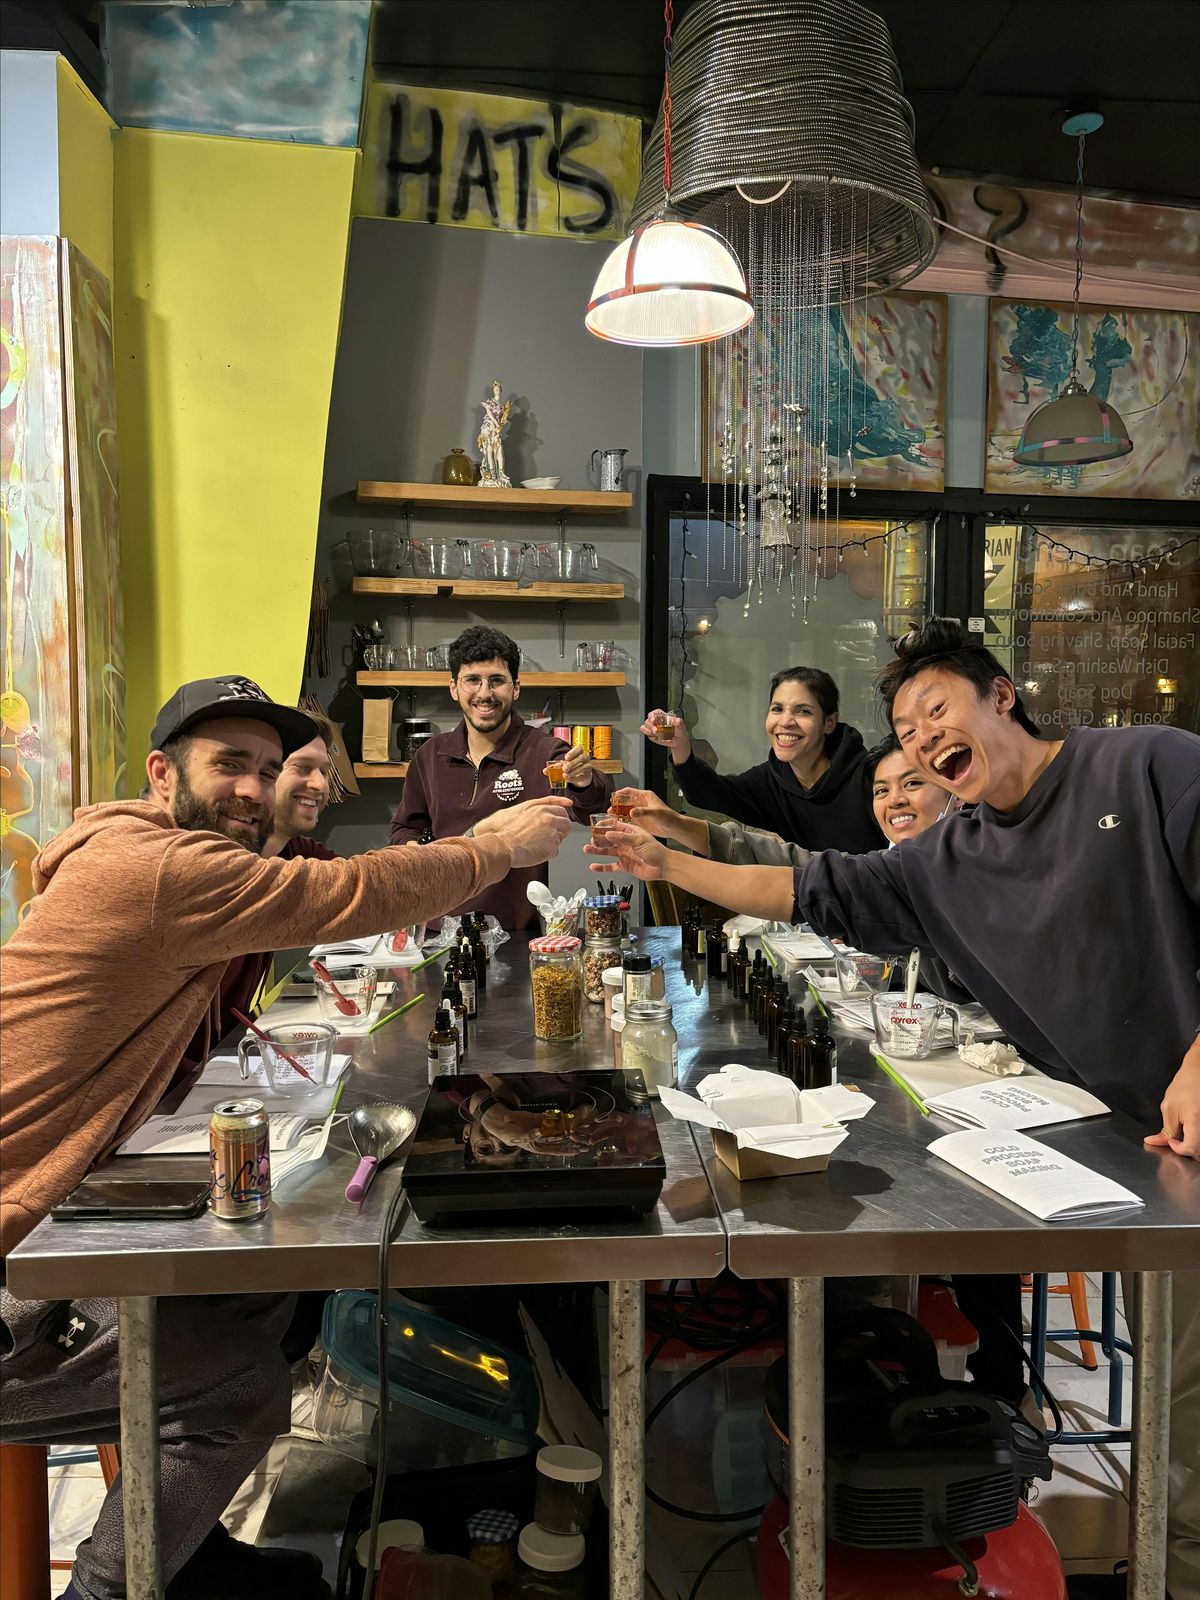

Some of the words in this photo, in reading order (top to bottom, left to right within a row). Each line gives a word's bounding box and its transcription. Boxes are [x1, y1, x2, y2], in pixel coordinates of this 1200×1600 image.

[494, 780, 523, 789] Roots
[890, 1016, 918, 1026] pyrex
[979, 1094, 1011, 1109] COLD
[983, 1144, 1021, 1155] COLD
[981, 1150, 1045, 1165] PROCESS
[1004, 1158, 1042, 1168] SOAP
[1008, 1163, 1064, 1177] MAKING
